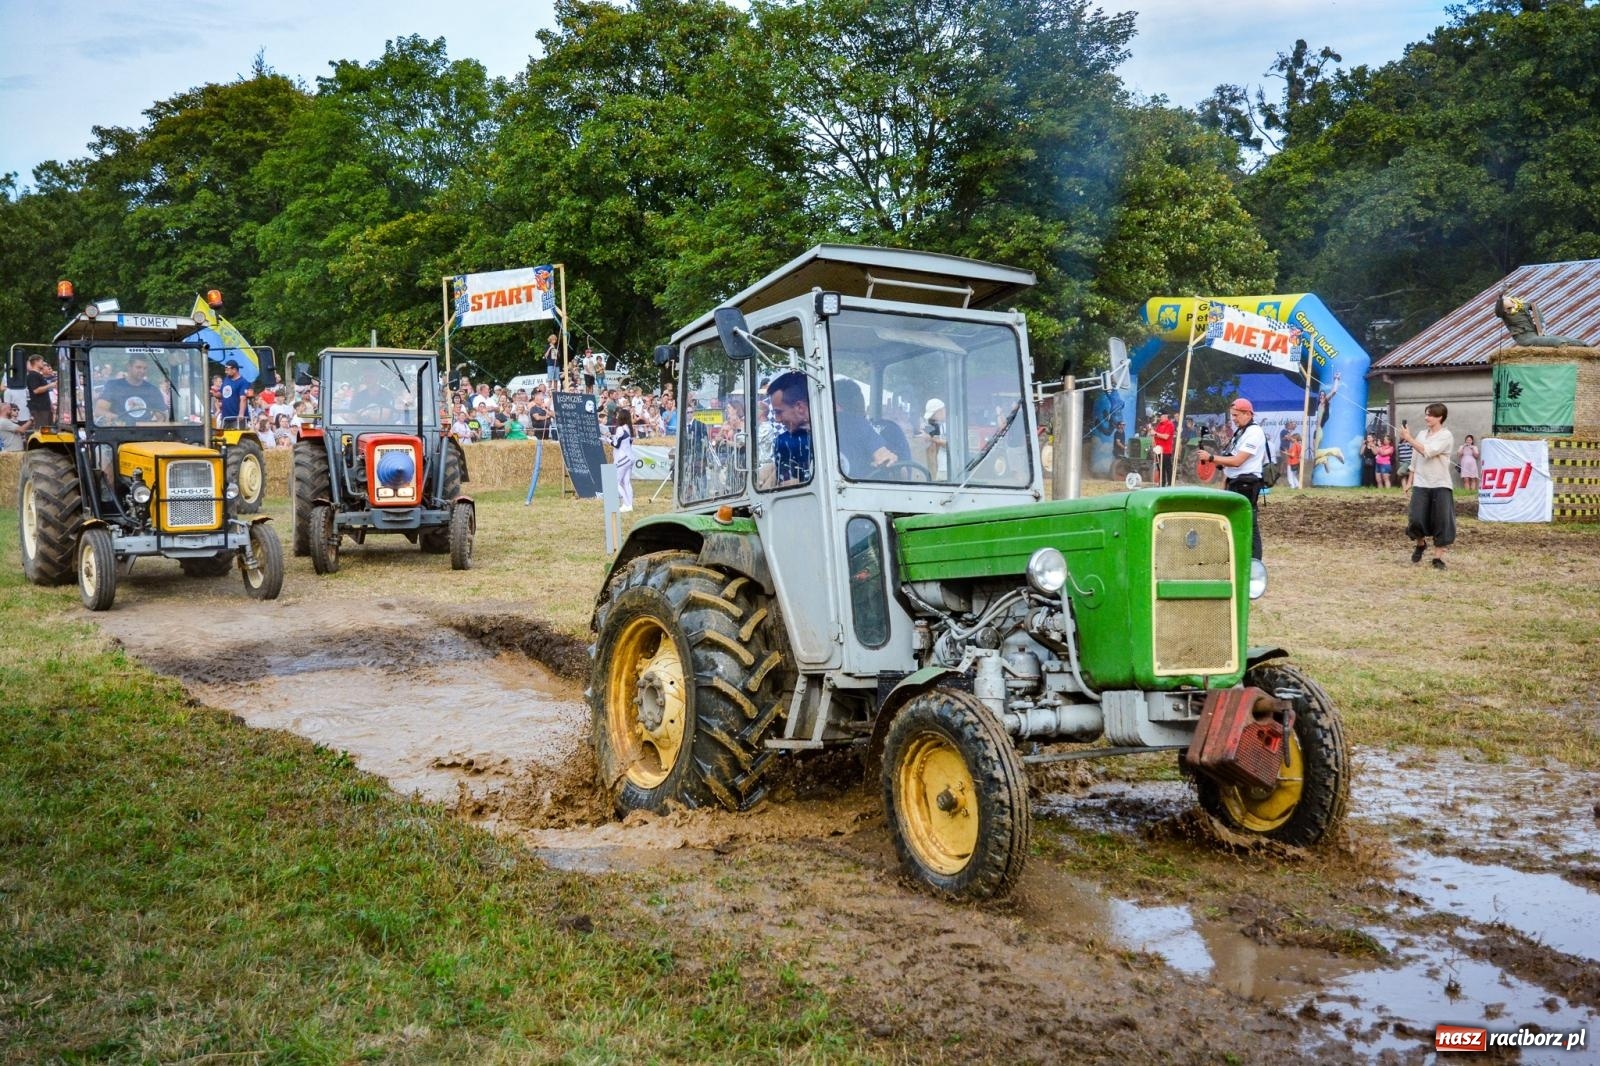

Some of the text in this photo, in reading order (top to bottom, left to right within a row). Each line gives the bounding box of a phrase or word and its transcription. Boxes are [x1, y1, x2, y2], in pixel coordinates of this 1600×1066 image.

[470, 284, 535, 312] START
[133, 316, 169, 327] TOMEK
[1223, 322, 1290, 354] META
